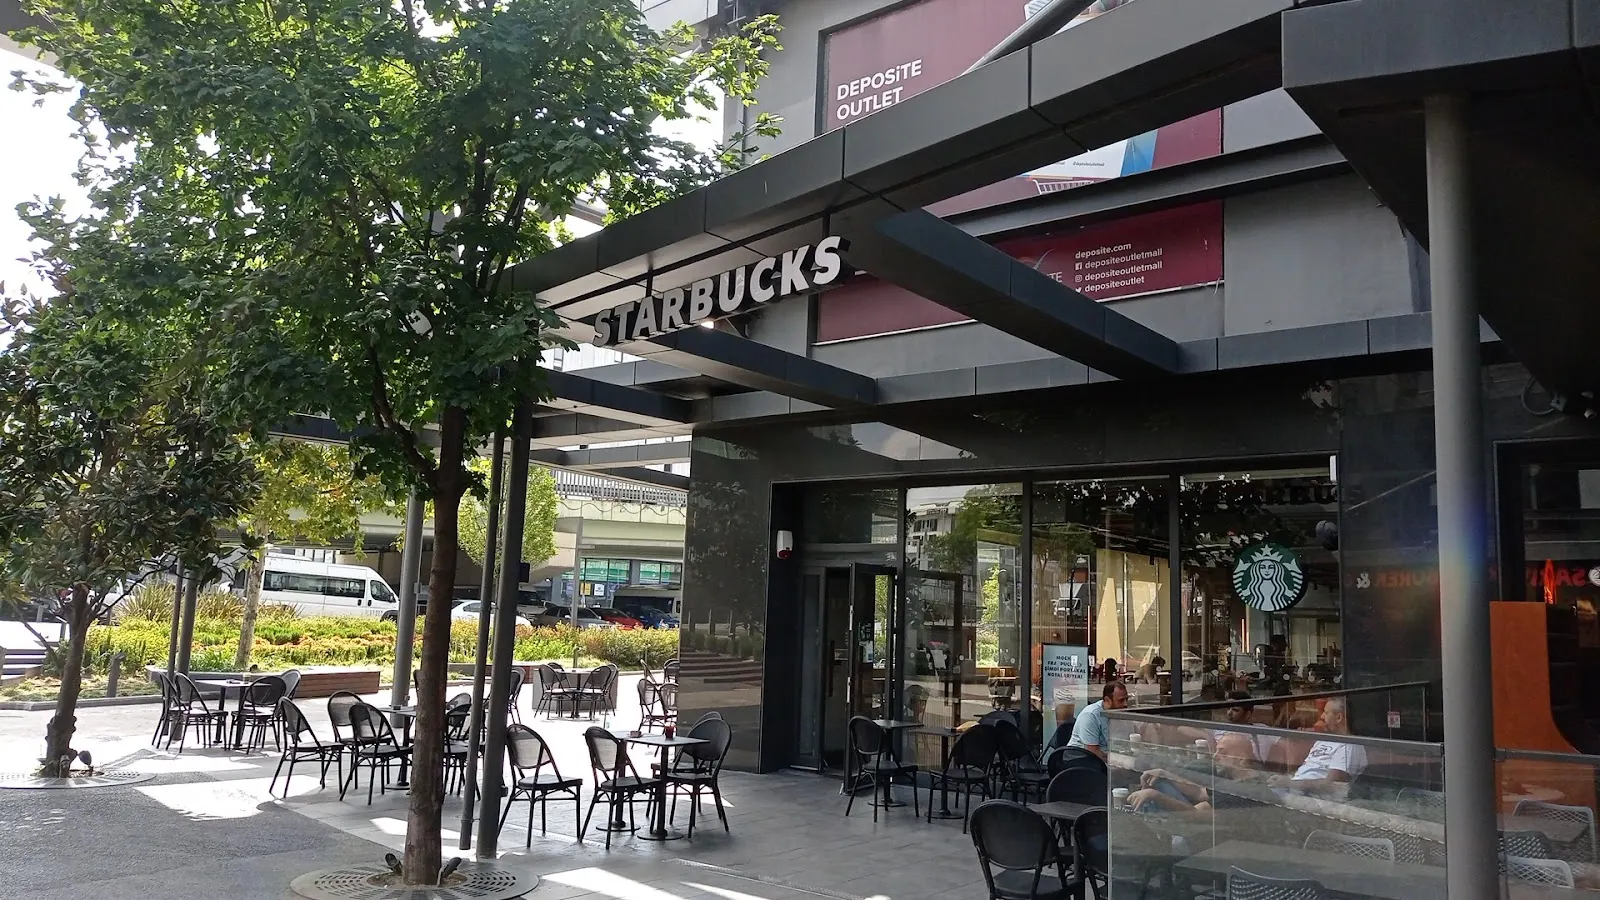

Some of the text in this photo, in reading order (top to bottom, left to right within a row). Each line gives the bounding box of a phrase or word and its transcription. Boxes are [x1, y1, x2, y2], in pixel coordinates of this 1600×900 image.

[836, 86, 903, 120] OUTLET
[1075, 242, 1132, 259] deposite.com
[1085, 248, 1163, 269] depositeoutletmall
[1084, 261, 1163, 282] depositeoutletmall
[593, 235, 845, 347] STARBUCKS
[1084, 276, 1145, 293] depositeoutlet
